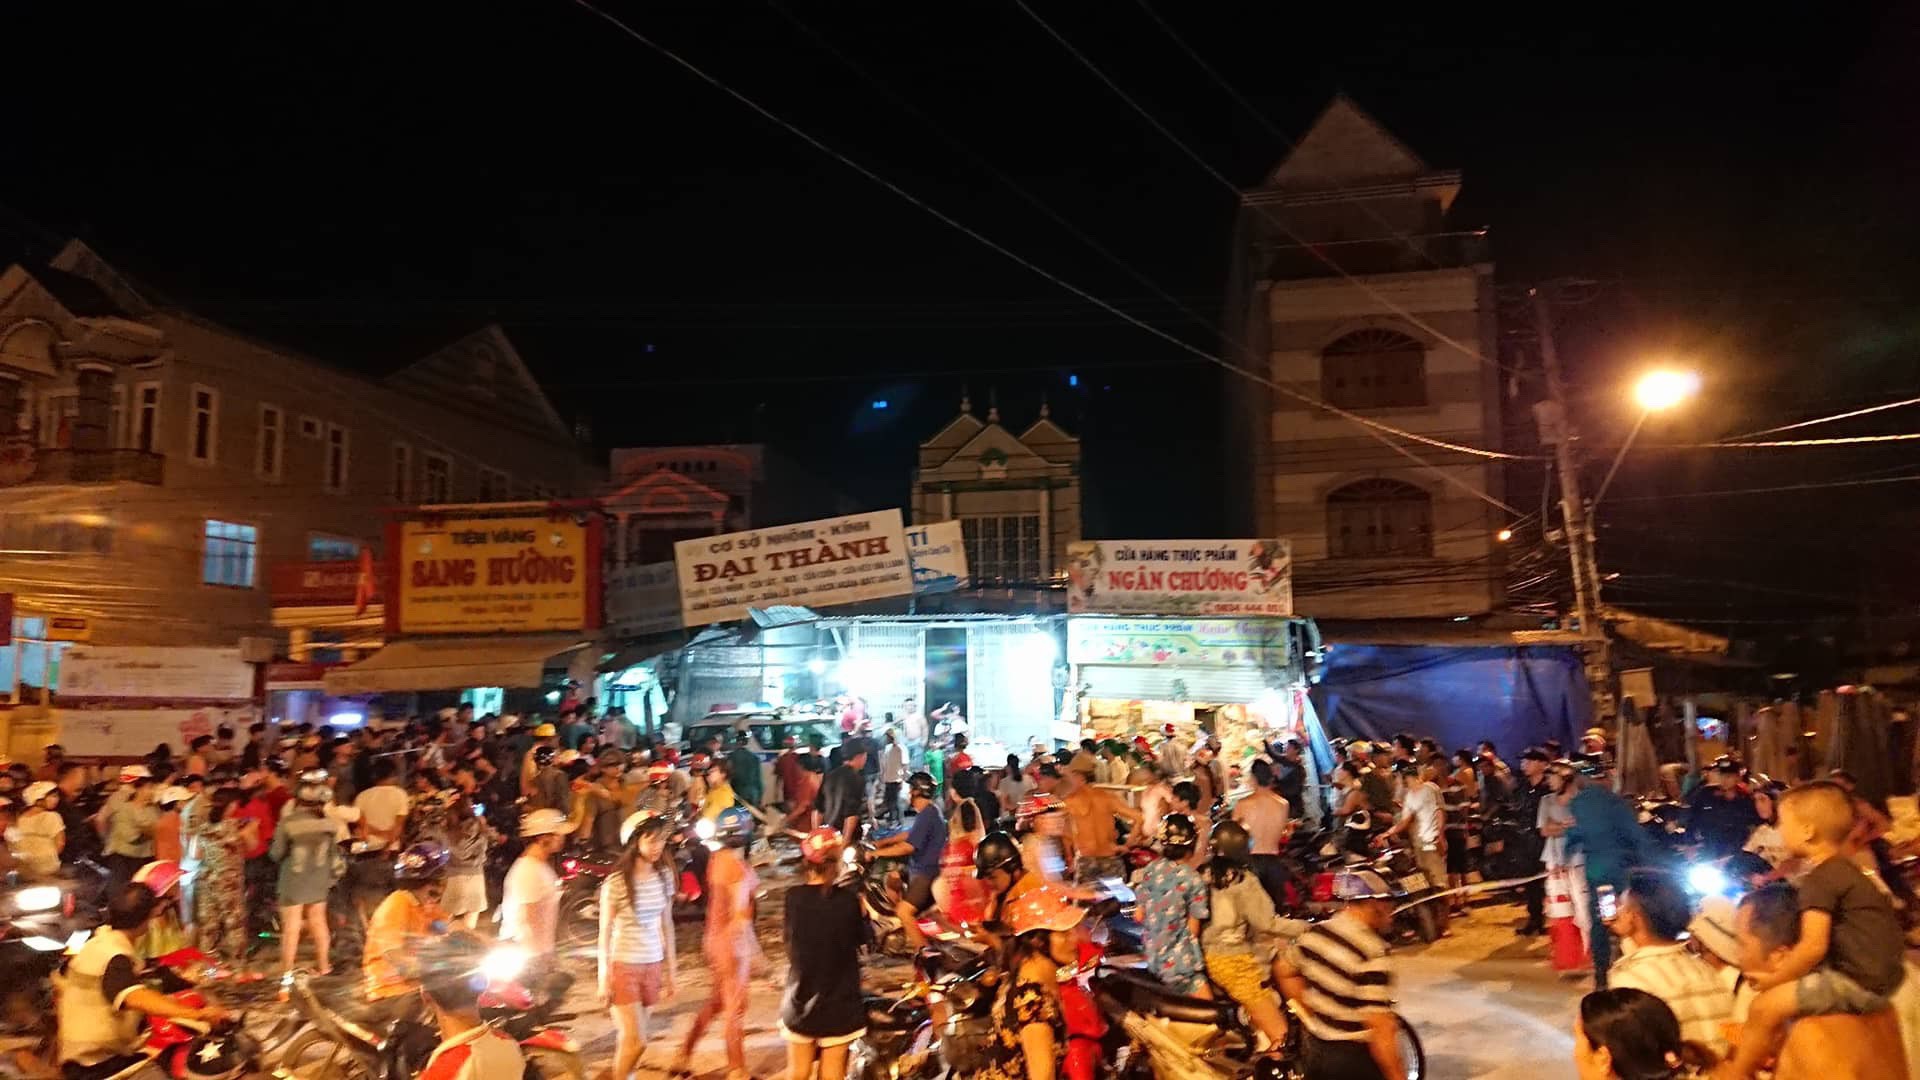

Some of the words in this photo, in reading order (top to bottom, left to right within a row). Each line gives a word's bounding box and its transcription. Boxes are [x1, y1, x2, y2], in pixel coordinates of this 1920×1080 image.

[710, 541, 732, 553] CƠ
[738, 533, 760, 549] SỞ
[830, 520, 870, 535] KÍNH
[411, 558, 476, 588] SANG
[487, 547, 576, 586] HƯỜNG
[692, 556, 757, 582] ĐẠI
[765, 535, 891, 571] THÀNH
[1108, 565, 1162, 591] NGÂN
[1168, 567, 1248, 591] CHƯƠNG
